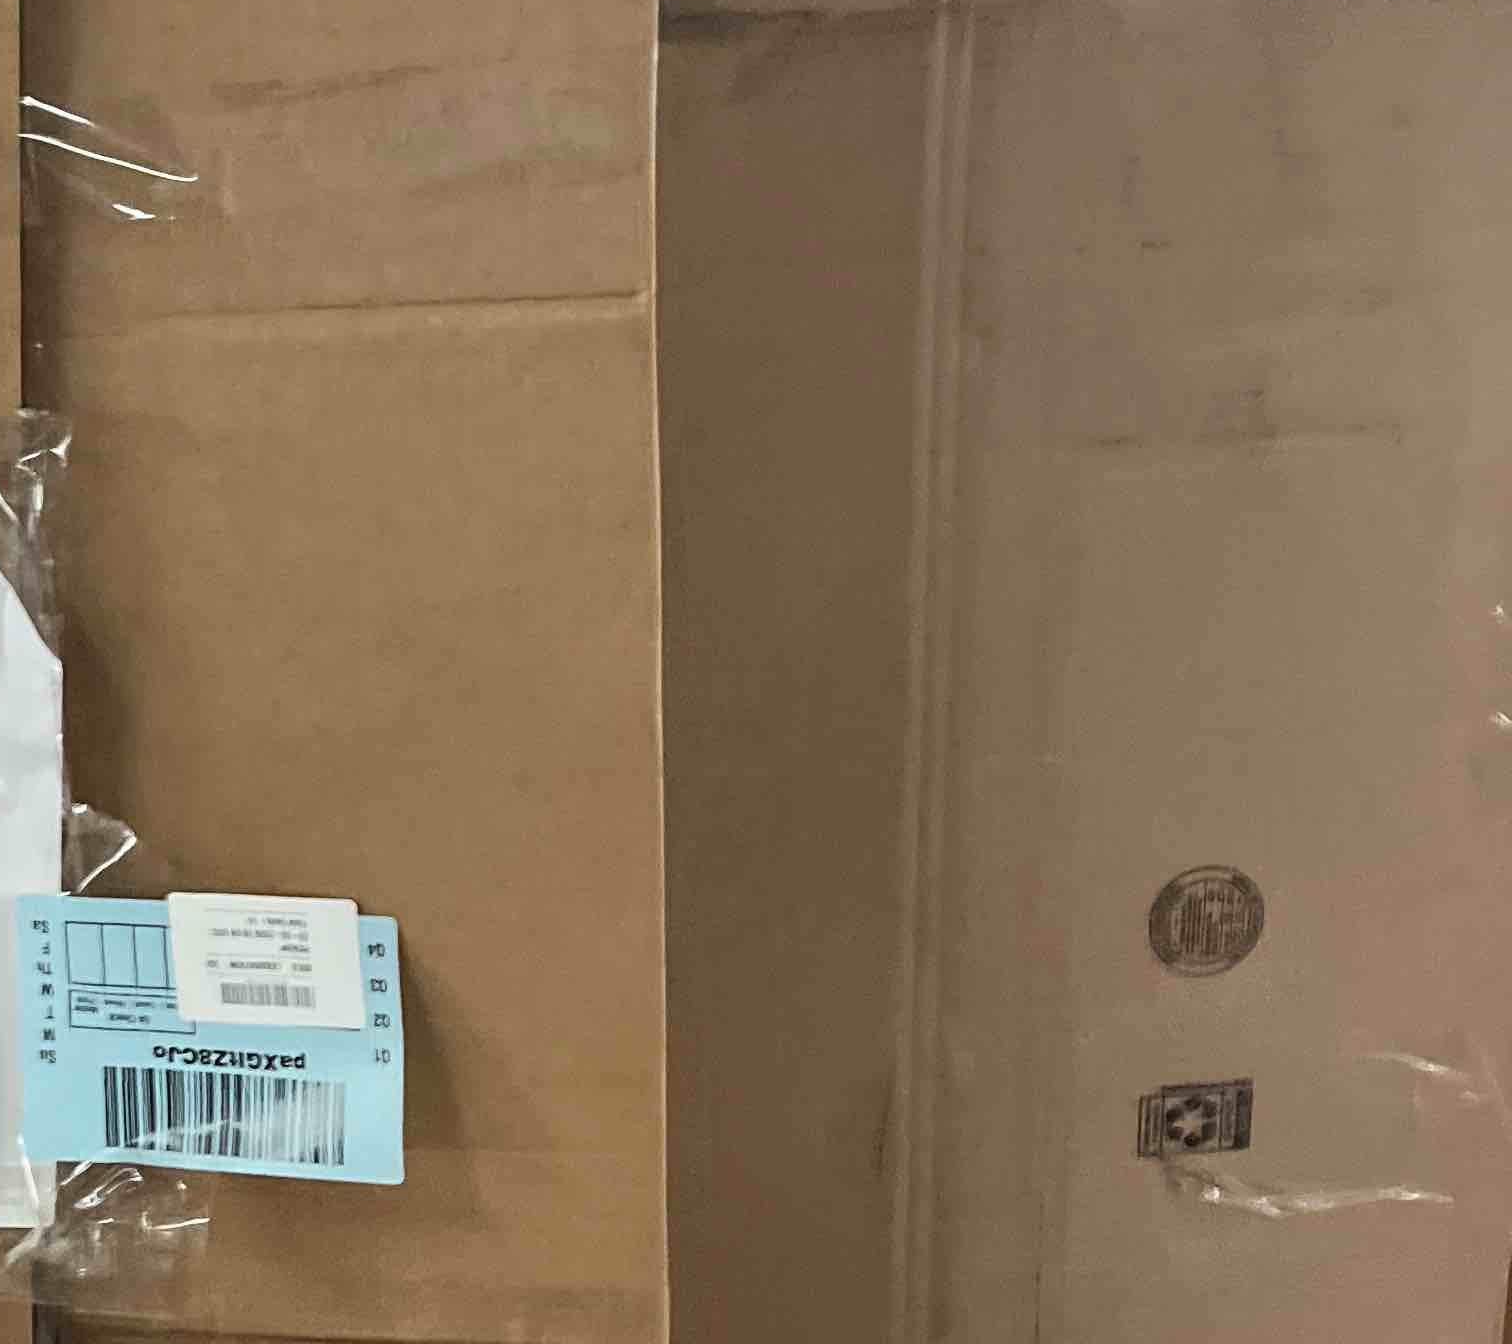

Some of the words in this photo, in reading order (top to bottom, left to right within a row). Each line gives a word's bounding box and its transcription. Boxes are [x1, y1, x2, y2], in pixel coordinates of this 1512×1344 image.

[32, 920, 50, 934] Sa
[368, 943, 386, 958] Q4
[40, 984, 55, 997] W
[370, 978, 388, 993] Q3
[373, 1013, 390, 1028] Q2
[375, 1049, 391, 1064] Q1
